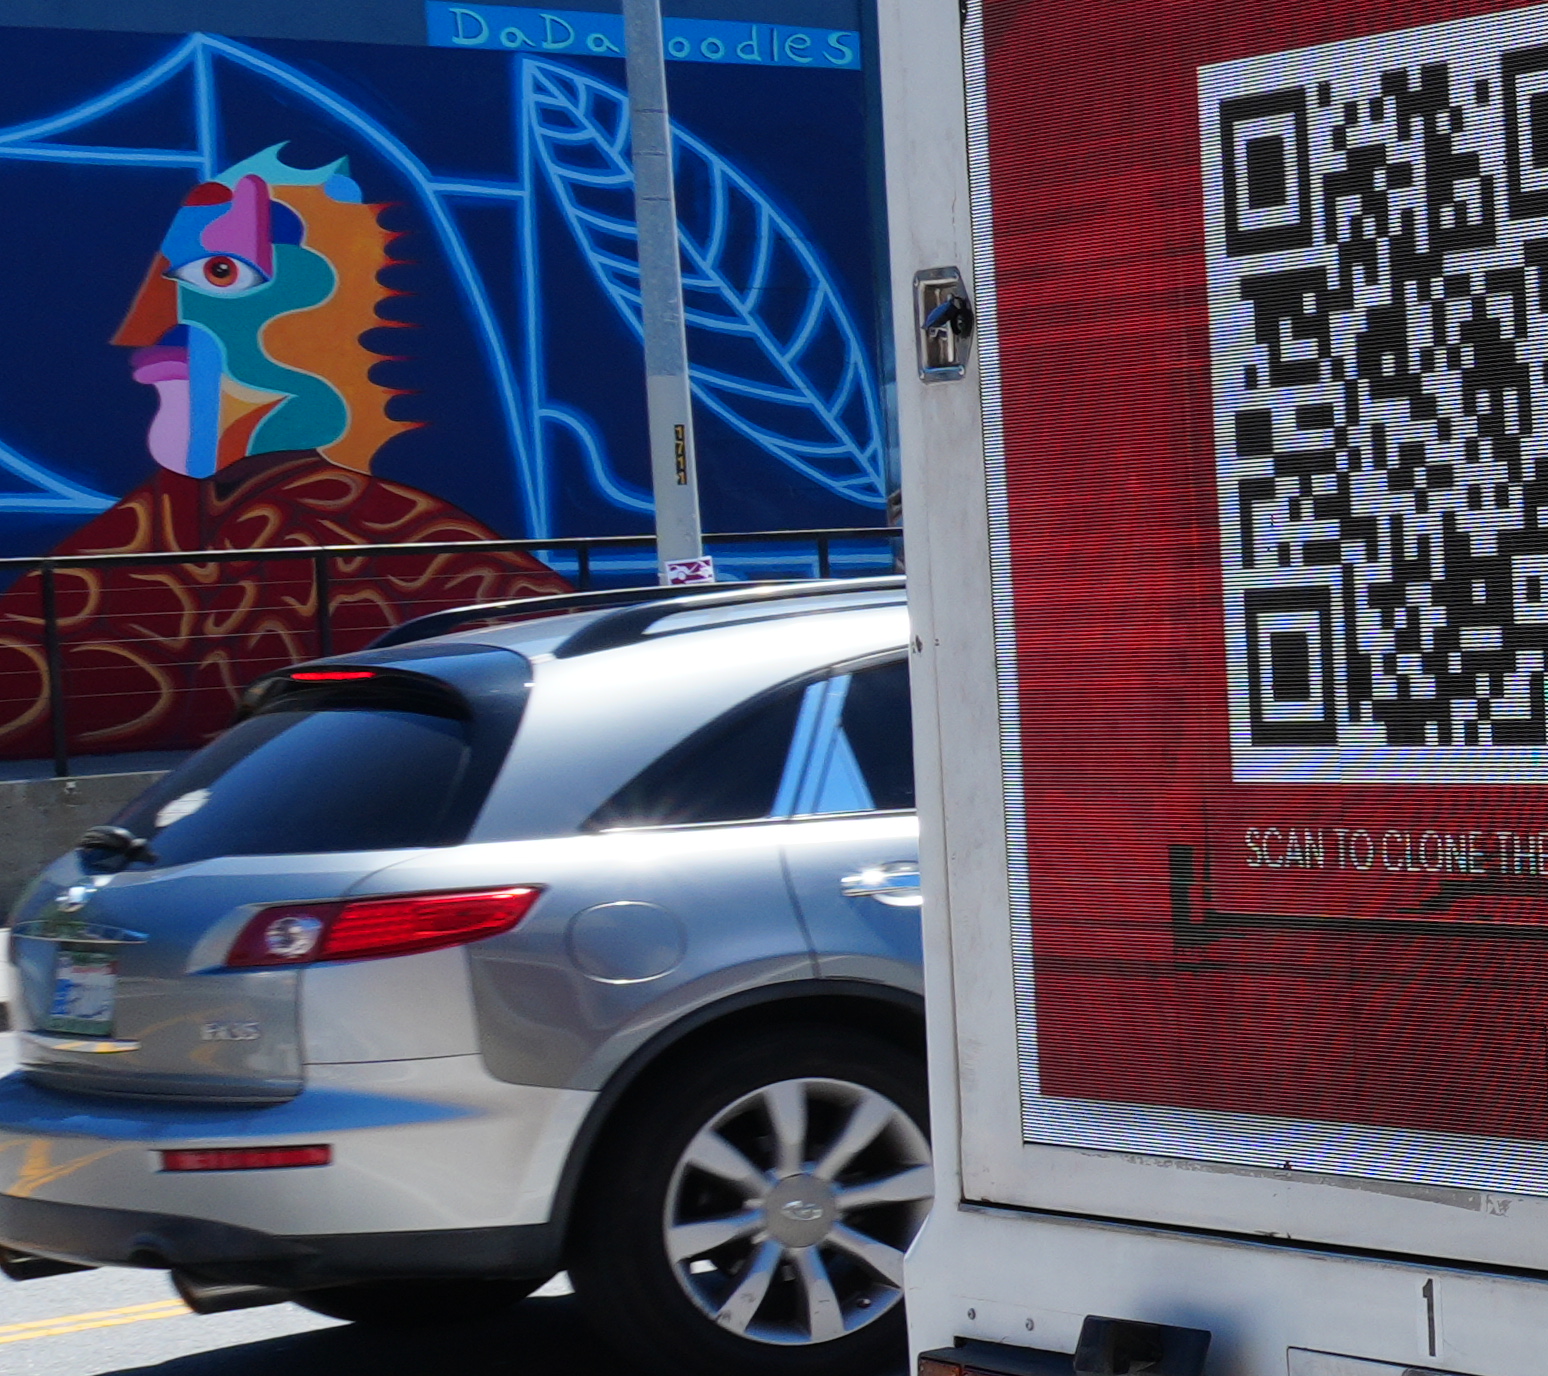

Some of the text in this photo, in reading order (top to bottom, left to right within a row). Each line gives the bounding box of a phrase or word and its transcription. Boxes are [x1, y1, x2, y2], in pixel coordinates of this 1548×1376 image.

[449, 8, 855, 65] DaDaoodles
[1244, 826, 1325, 869] SCAN
[1333, 827, 1375, 871] TO
[1381, 829, 1487, 874] CLONE
[1422, 1277, 1437, 1358] 1
